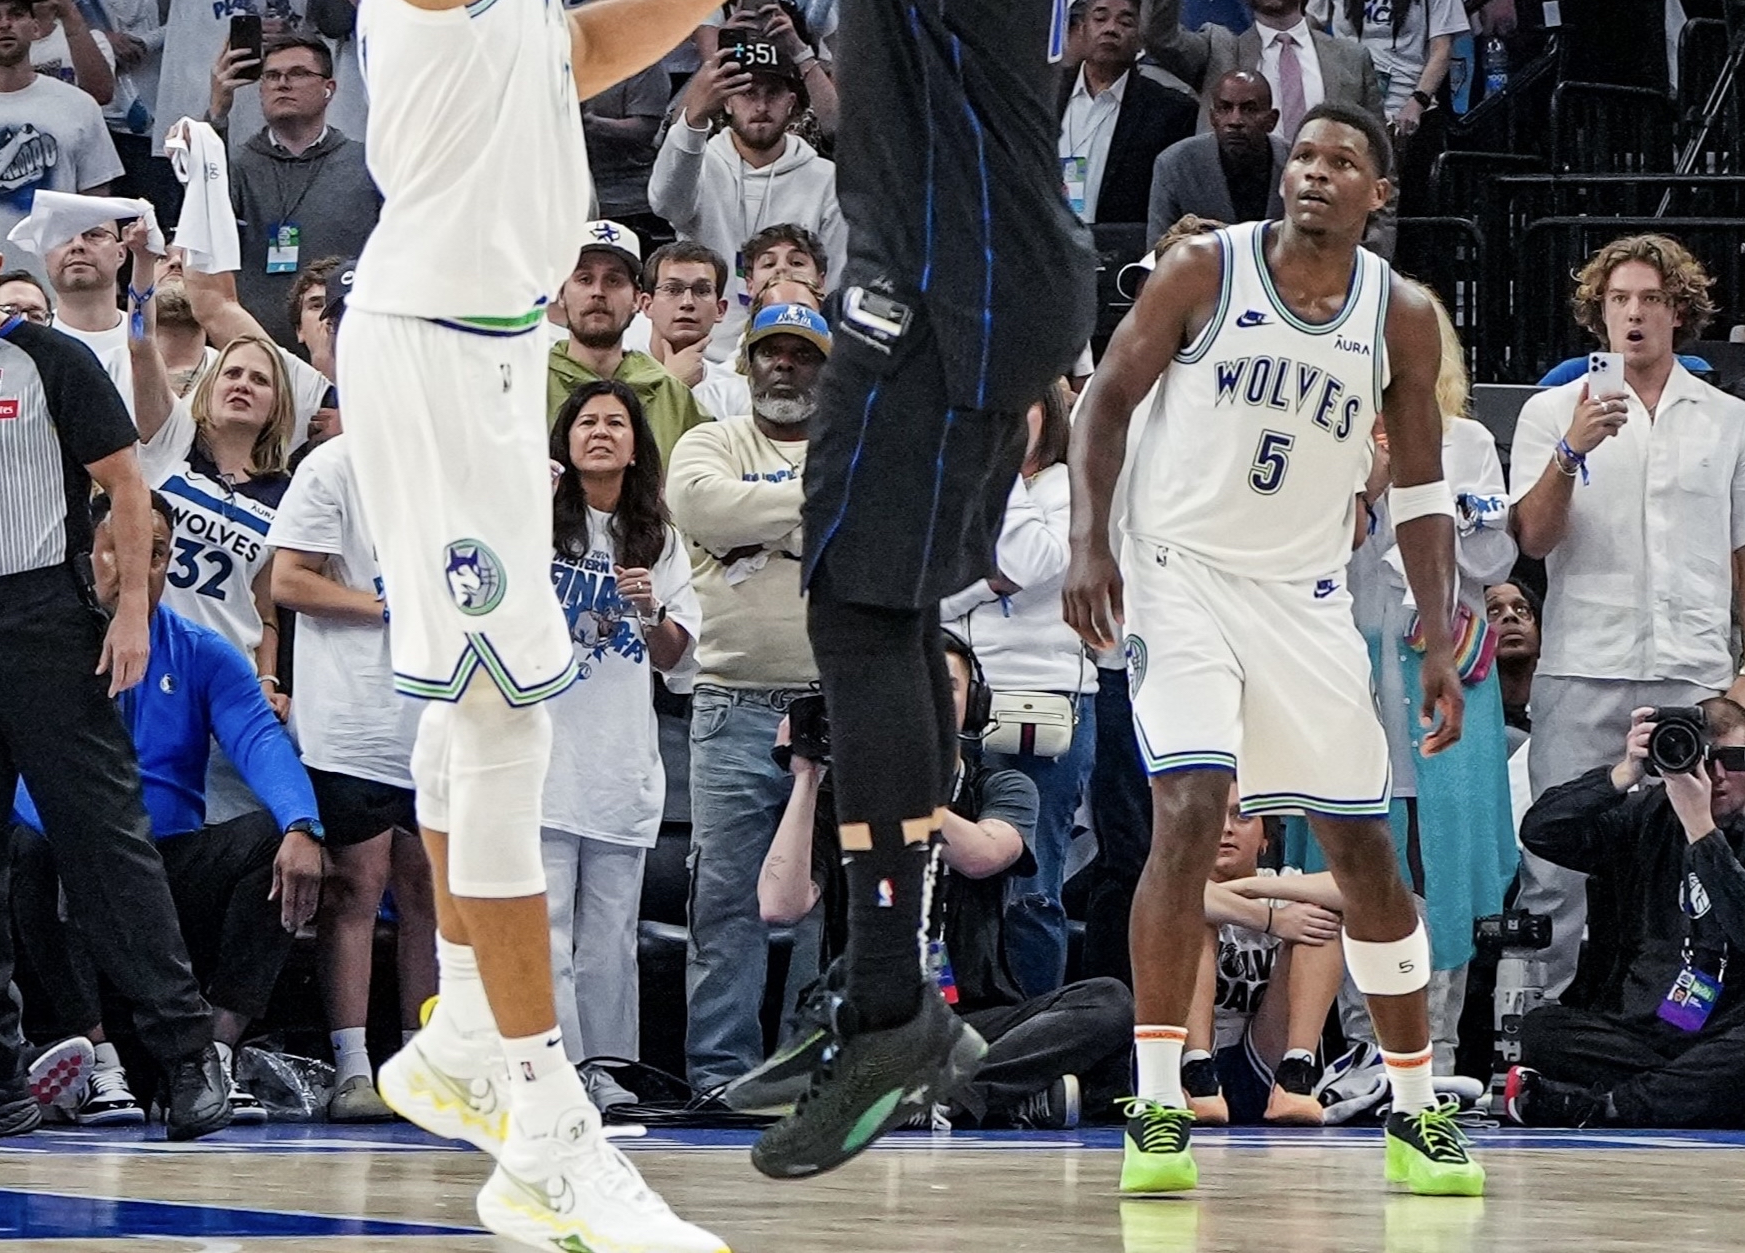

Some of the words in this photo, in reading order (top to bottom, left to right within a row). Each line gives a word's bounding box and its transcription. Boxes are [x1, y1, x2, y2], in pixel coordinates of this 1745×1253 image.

[1214, 352, 1361, 443] WOLVES
[1247, 428, 1296, 496] 5
[166, 536, 233, 600] 32
[1398, 958, 1415, 975] 5
